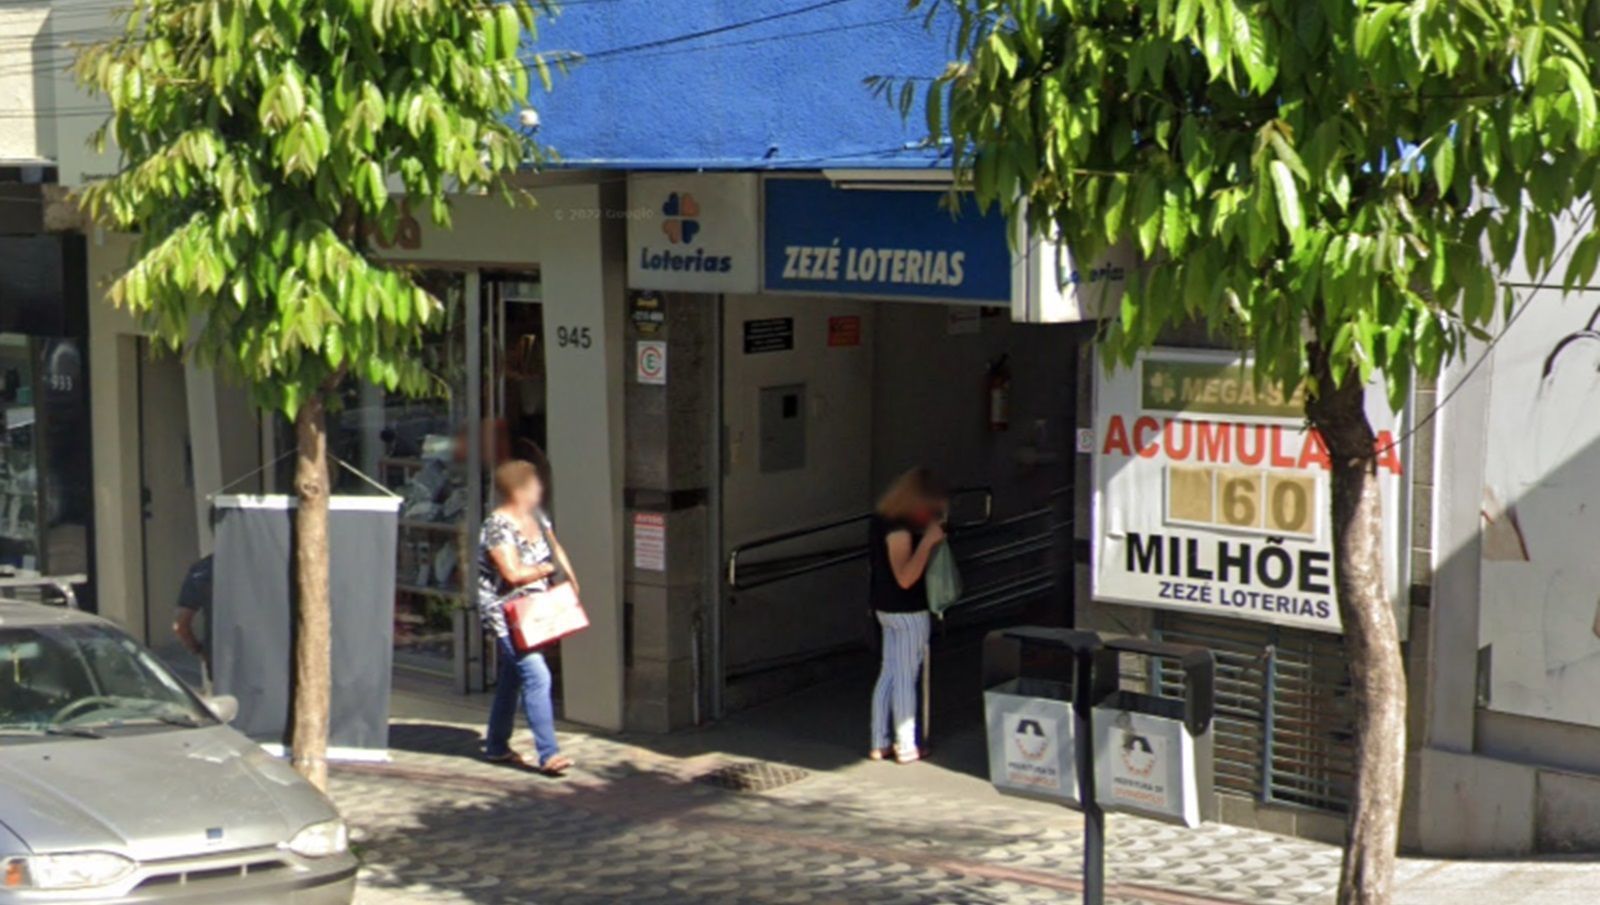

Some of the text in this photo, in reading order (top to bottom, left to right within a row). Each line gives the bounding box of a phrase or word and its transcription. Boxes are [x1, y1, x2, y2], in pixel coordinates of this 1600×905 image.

[641, 248, 732, 273] Loterias
[782, 237, 965, 286] ZEZÉ LOTERIAS
[556, 326, 592, 349] 945
[1103, 415, 1403, 475] ACUMULAA
[1222, 477, 1308, 532] 60
[1126, 533, 1331, 595] MILHÕE
[1158, 581, 1330, 619] ZEZÉ LOTERIAS
